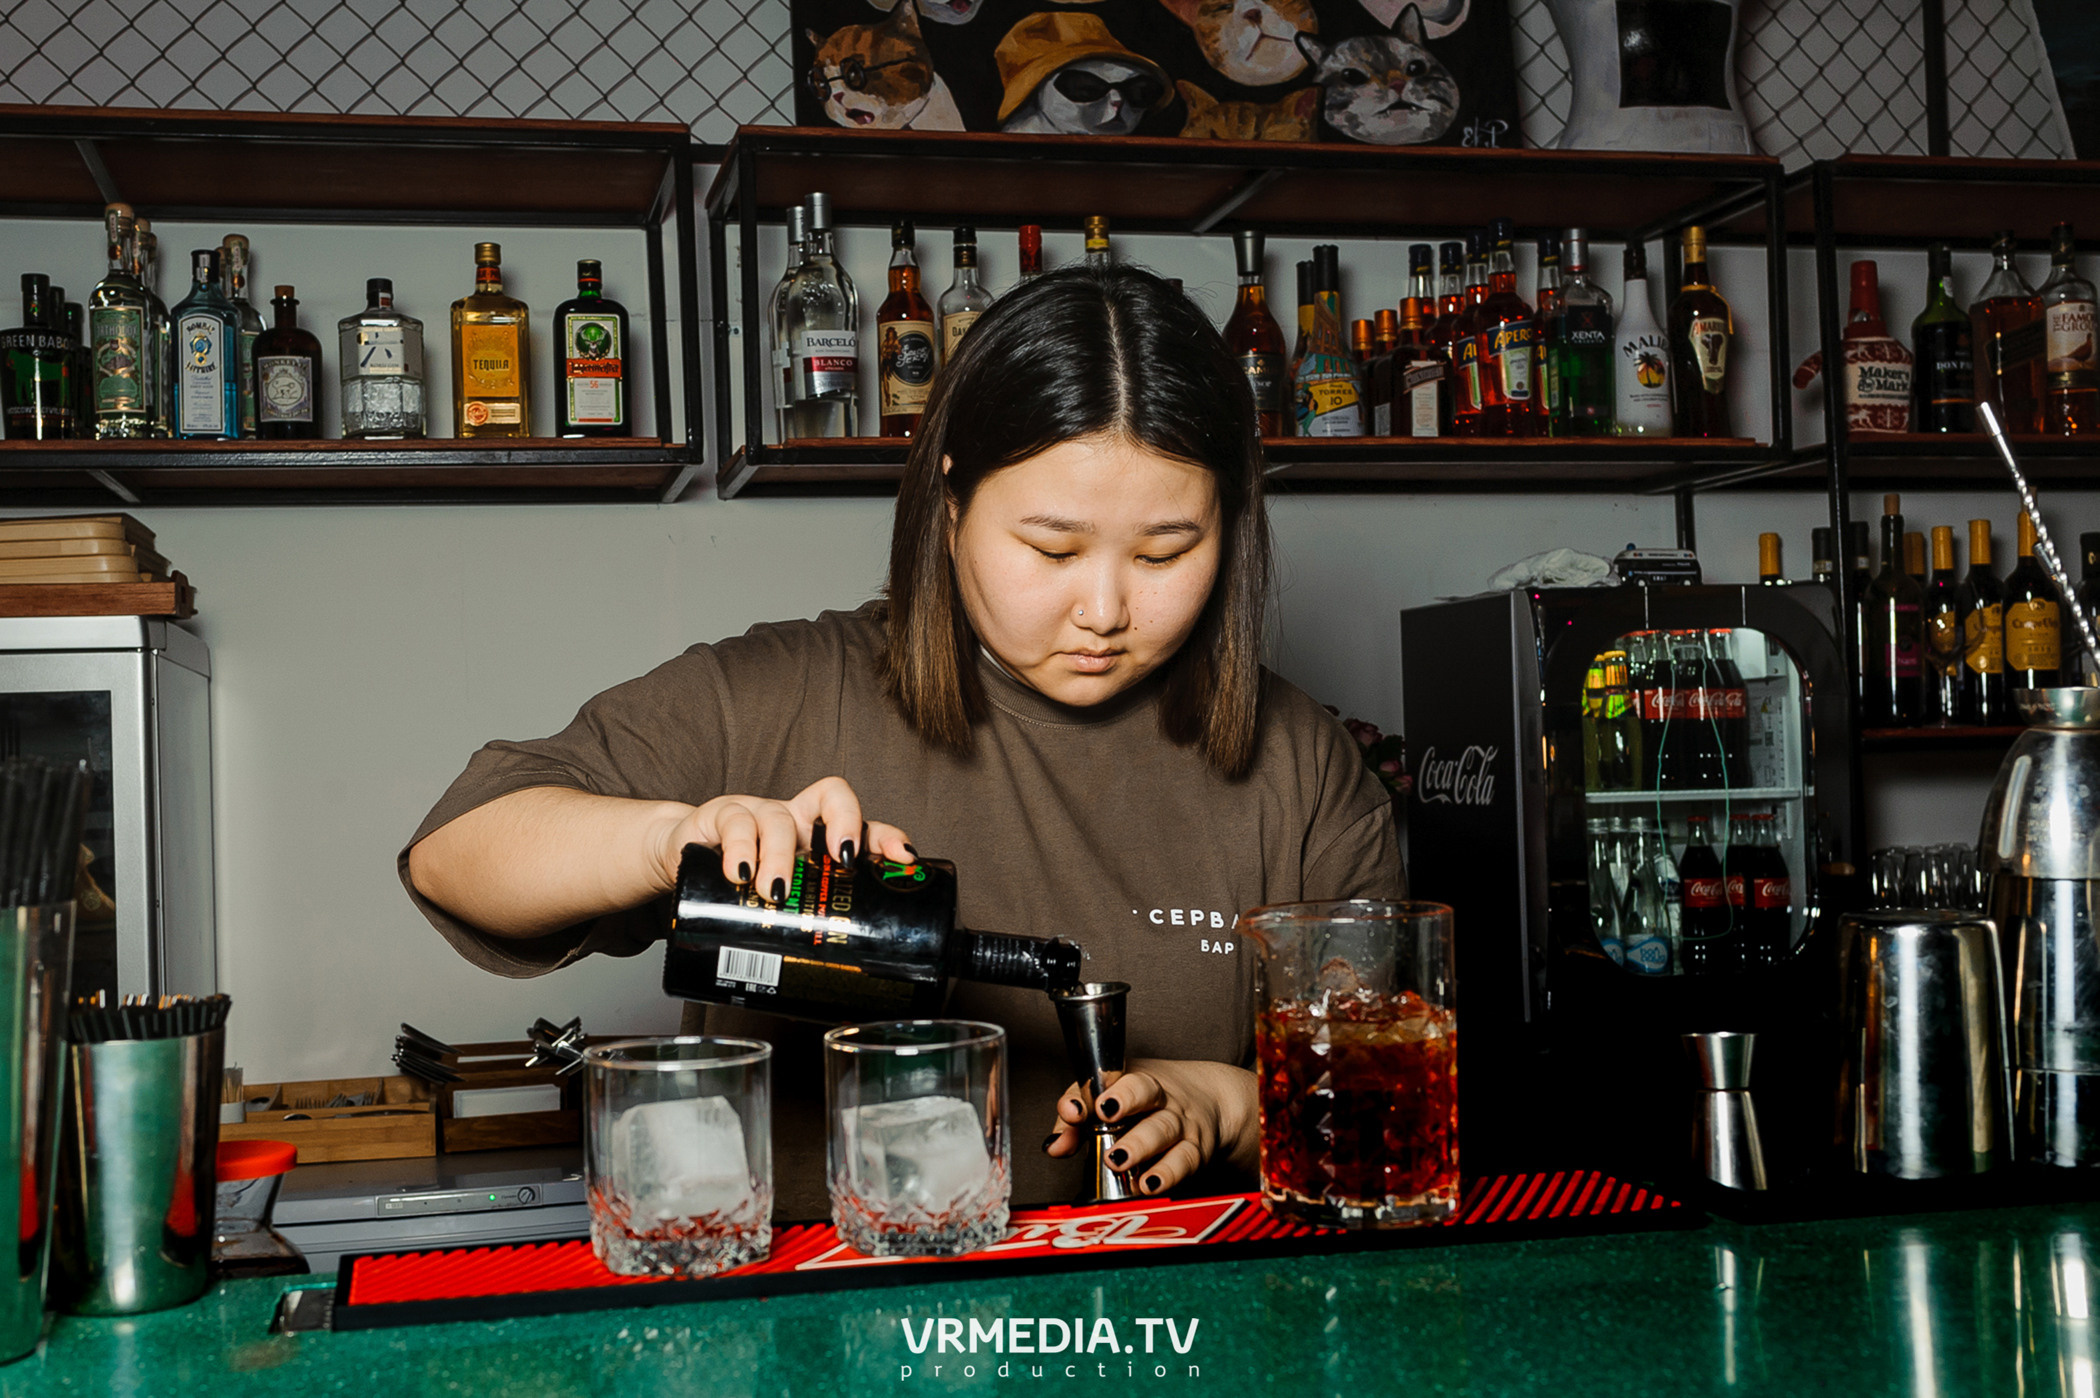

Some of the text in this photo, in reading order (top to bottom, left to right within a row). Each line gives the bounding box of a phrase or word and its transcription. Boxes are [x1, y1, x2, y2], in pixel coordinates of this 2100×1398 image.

[186, 322, 216, 336] BOMBAY
[1, 334, 35, 349] GREEN
[1571, 330, 1605, 341] XENTA
[806, 336, 857, 348] BARCELÓ
[473, 359, 509, 372] TEQUILA
[814, 358, 854, 367] BLANCO
[589, 380, 599, 389] 56
[1330, 396, 1343, 406] 10
[1417, 745, 1499, 806] Coca-Cola
[1200, 939, 1235, 955] БАР
